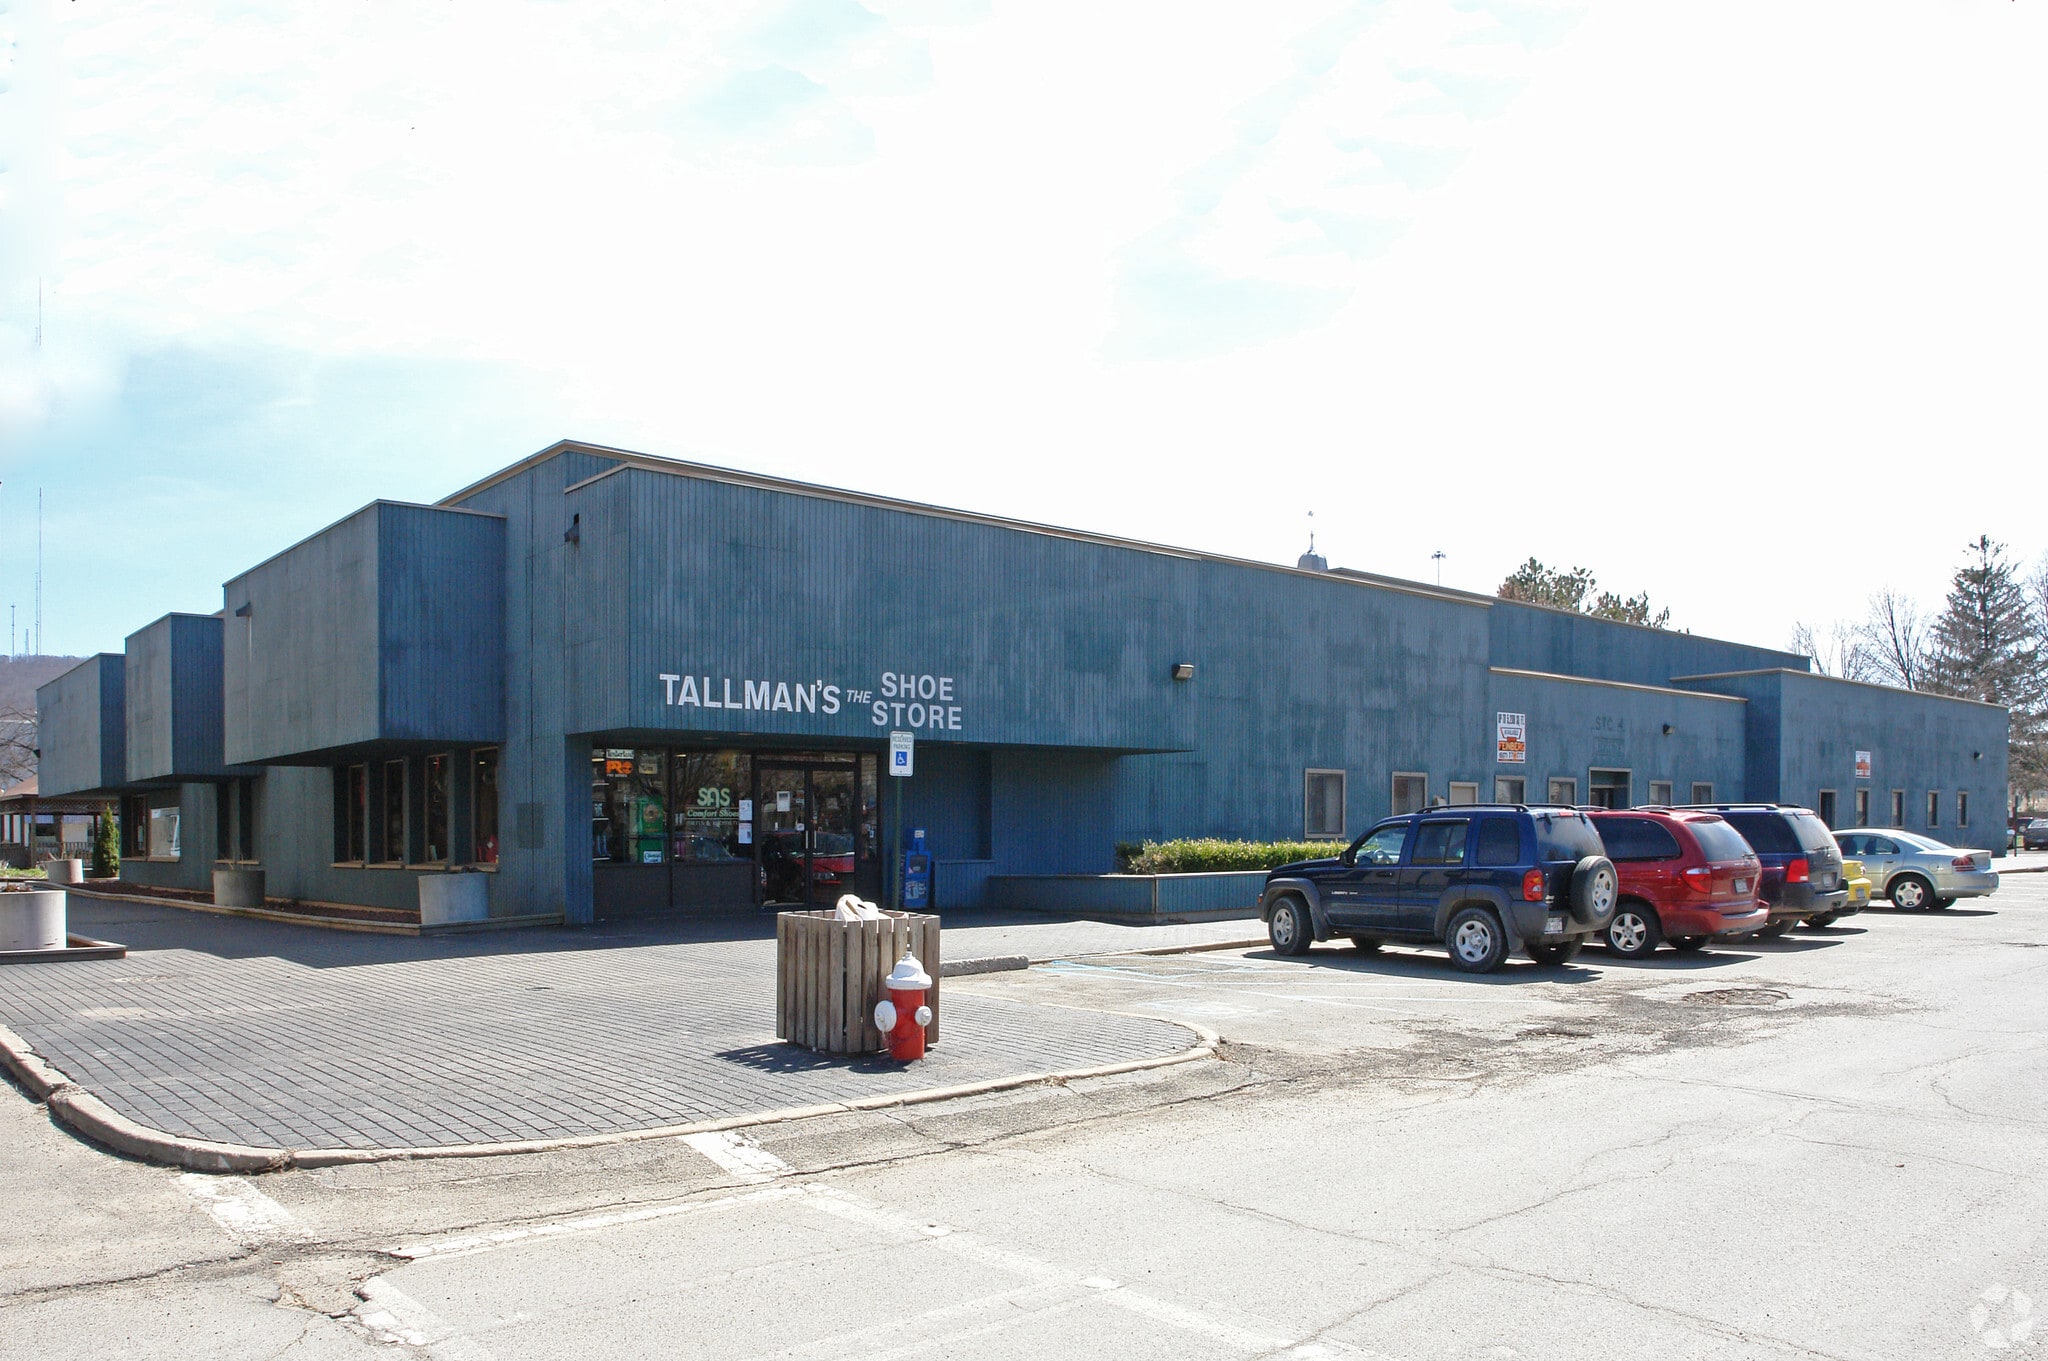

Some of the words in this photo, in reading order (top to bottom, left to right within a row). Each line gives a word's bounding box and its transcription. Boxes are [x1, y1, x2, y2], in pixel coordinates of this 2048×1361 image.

[659, 673, 841, 715] TALLMAN'S
[846, 689, 872, 704] THE
[881, 671, 954, 701] SHOE
[871, 700, 962, 730] STORE
[697, 787, 731, 808] SAS
[687, 809, 718, 818] Comfort
